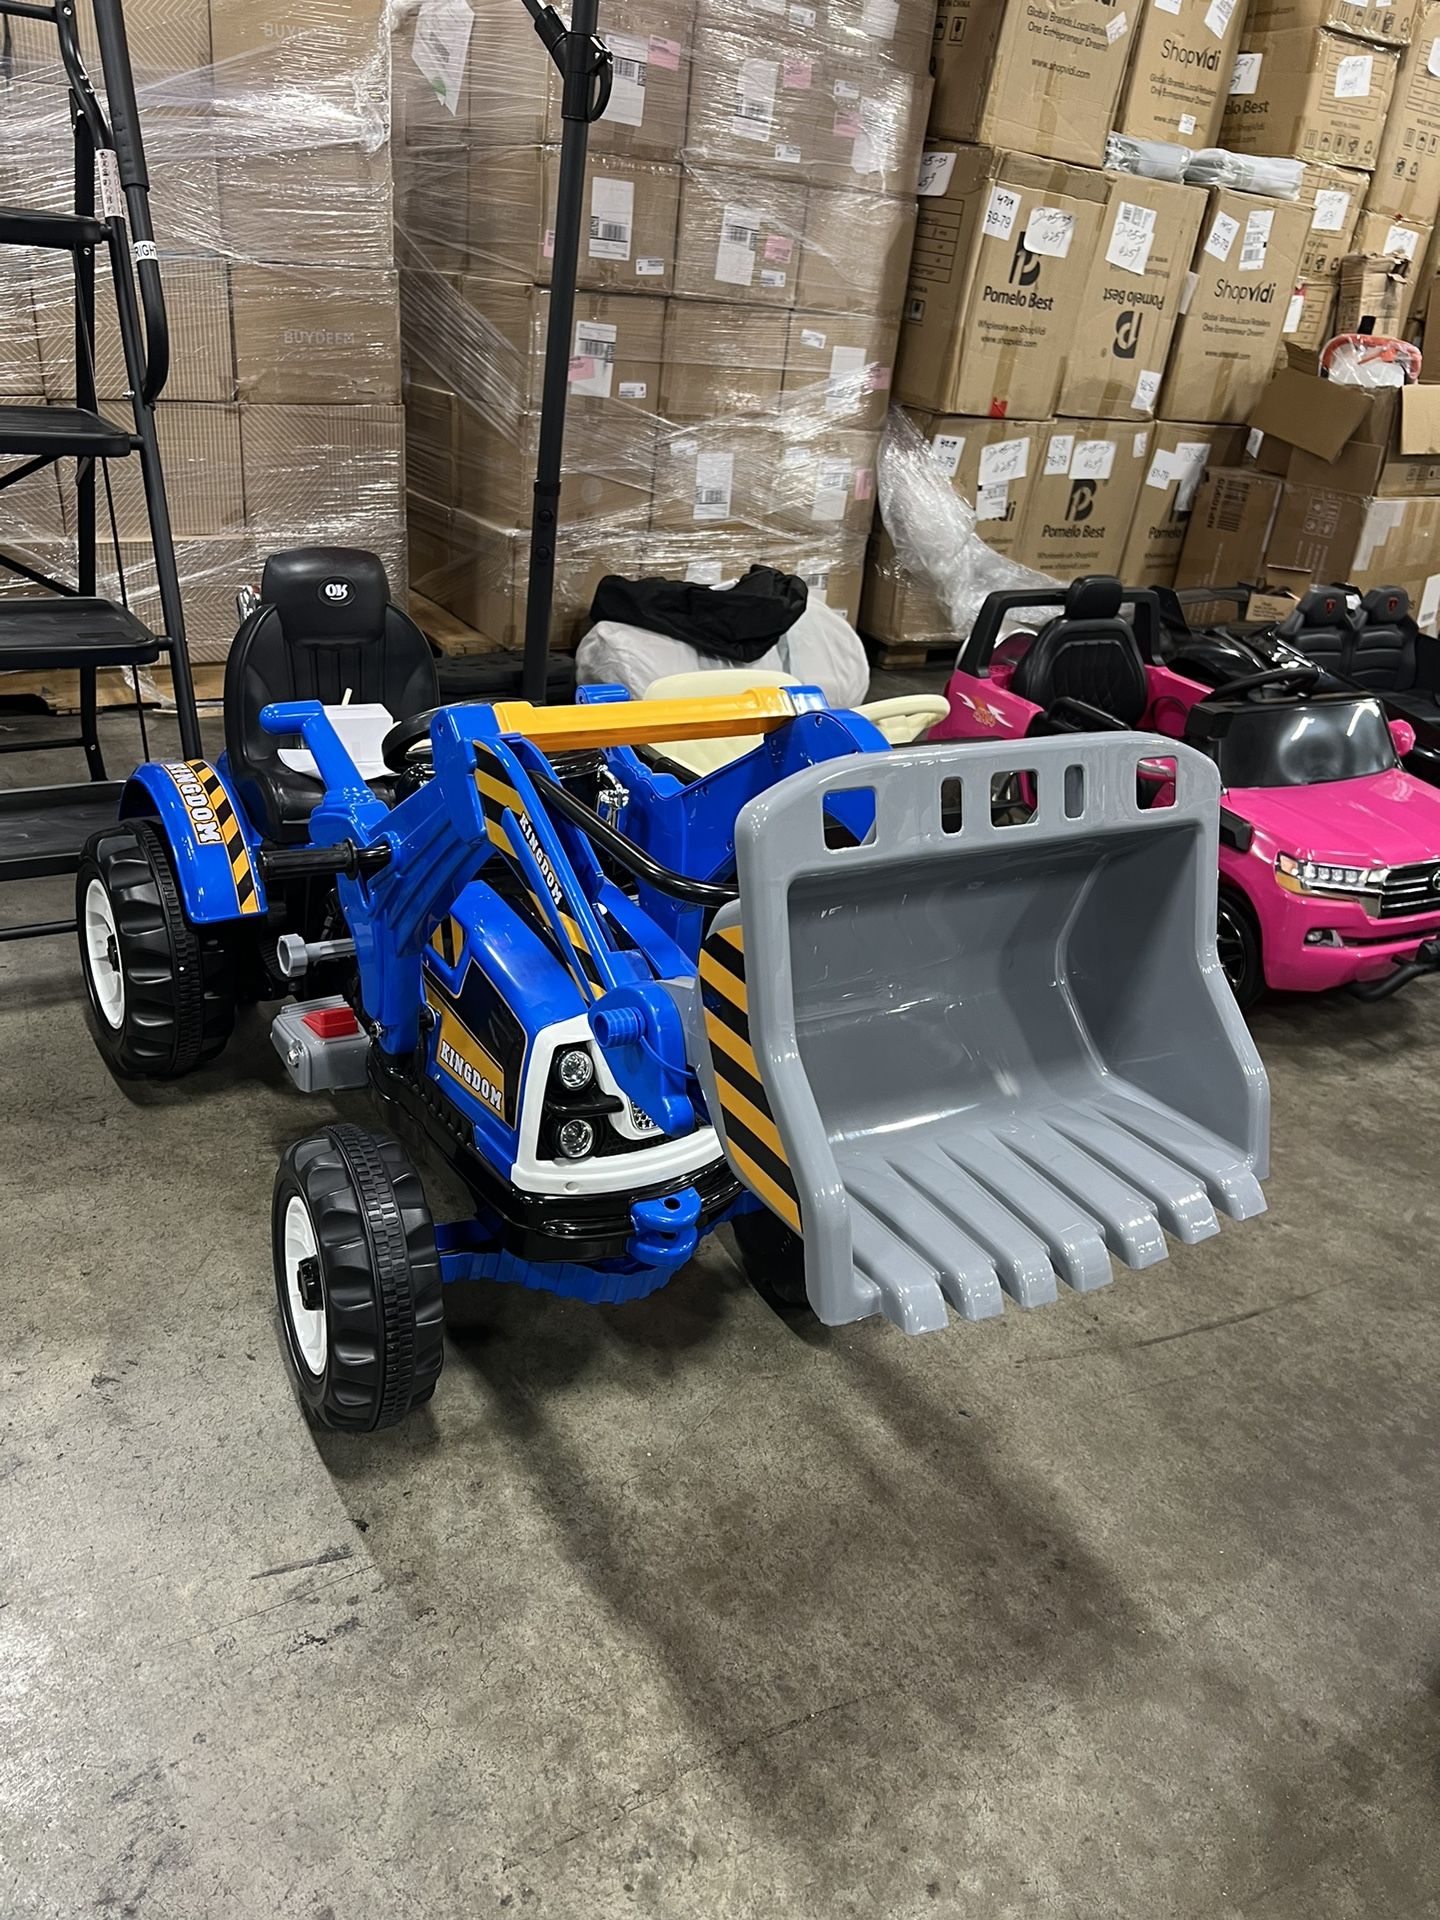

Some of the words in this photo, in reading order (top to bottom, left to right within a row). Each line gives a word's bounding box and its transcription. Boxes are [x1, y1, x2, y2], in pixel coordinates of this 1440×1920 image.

[1027, 5, 1049, 21] Global
[1028, 21, 1042, 34] One
[1243, 99, 1270, 114] Best
[983, 285, 1027, 307] Pomelo
[1028, 290, 1054, 311] Best
[1103, 287, 1126, 305] Best
[1127, 290, 1165, 310] Pomelo
[1214, 278, 1277, 304] Shopvidi
[1041, 525, 1082, 538] Pomelo
[1082, 525, 1106, 538] Best
[325, 583, 348, 600] OK
[162, 762, 222, 843] KINGDOM
[519, 811, 563, 905] KINGDOM
[440, 1039, 503, 1112] KINGDOM
